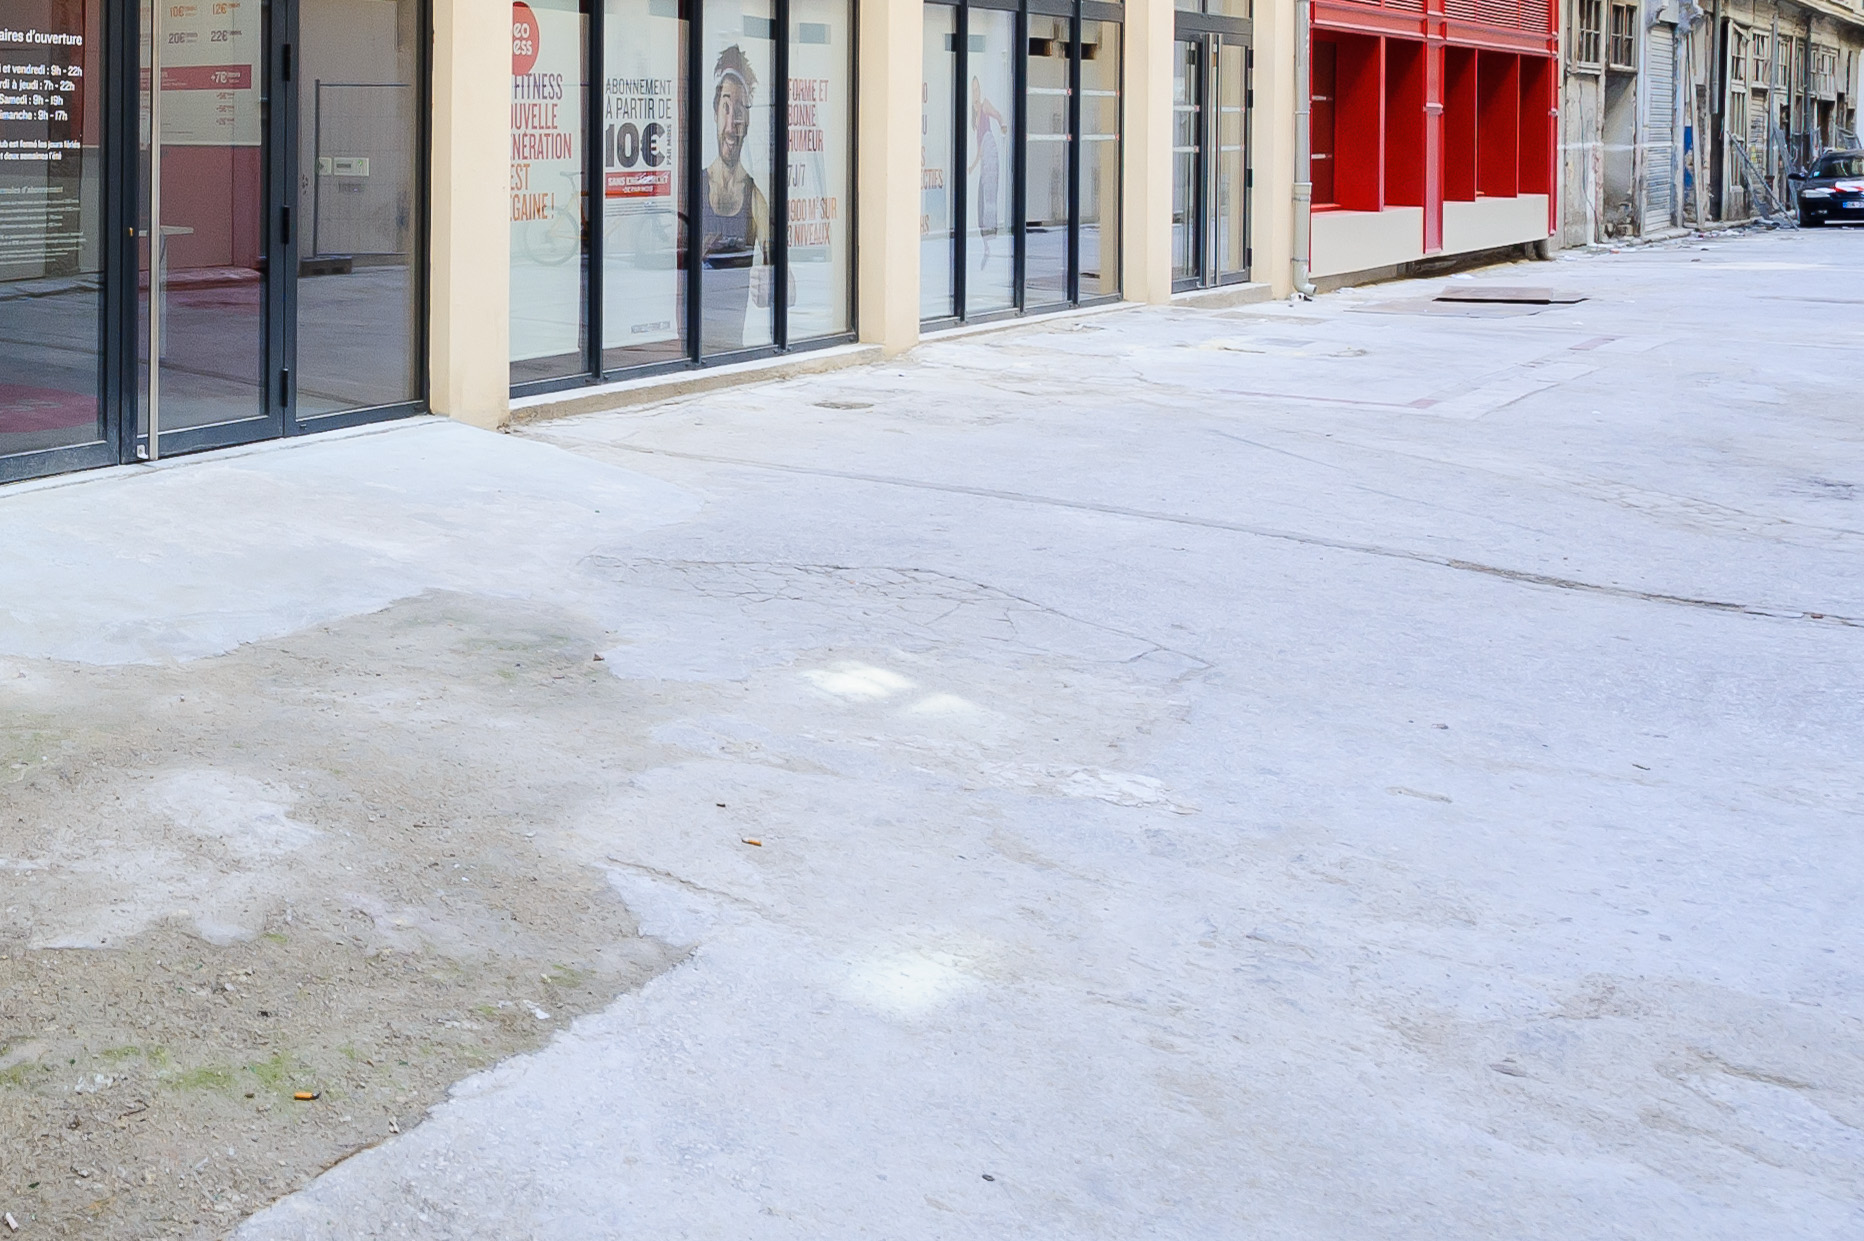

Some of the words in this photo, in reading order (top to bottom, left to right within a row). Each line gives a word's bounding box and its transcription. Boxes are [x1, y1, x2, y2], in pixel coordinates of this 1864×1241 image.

[513, 23, 530, 38] eo
[514, 40, 533, 55] ess
[2, 64, 11, 73] et
[12, 64, 45, 75] vendredi
[51, 65, 61, 76] 9h
[68, 66, 83, 77] 22h
[12, 79, 17, 89] à
[19, 79, 38, 91] jeudi
[44, 80, 54, 91] 7h
[59, 80, 75, 91] 22h
[514, 73, 563, 100] FITNESS
[605, 78, 672, 95] ABONNEMENT
[788, 78, 816, 101] FORME
[819, 79, 829, 102] ET
[55, 110, 68, 121] 17h
[605, 95, 613, 119] À
[616, 97, 655, 119] PARTIR
[658, 98, 672, 119] DE
[511, 130, 572, 160] NÉRATION
[605, 122, 666, 168] 10€
[788, 129, 824, 152] HUMEUR
[510, 193, 548, 221] GAINE
[794, 222, 830, 247] NIVEAUX
